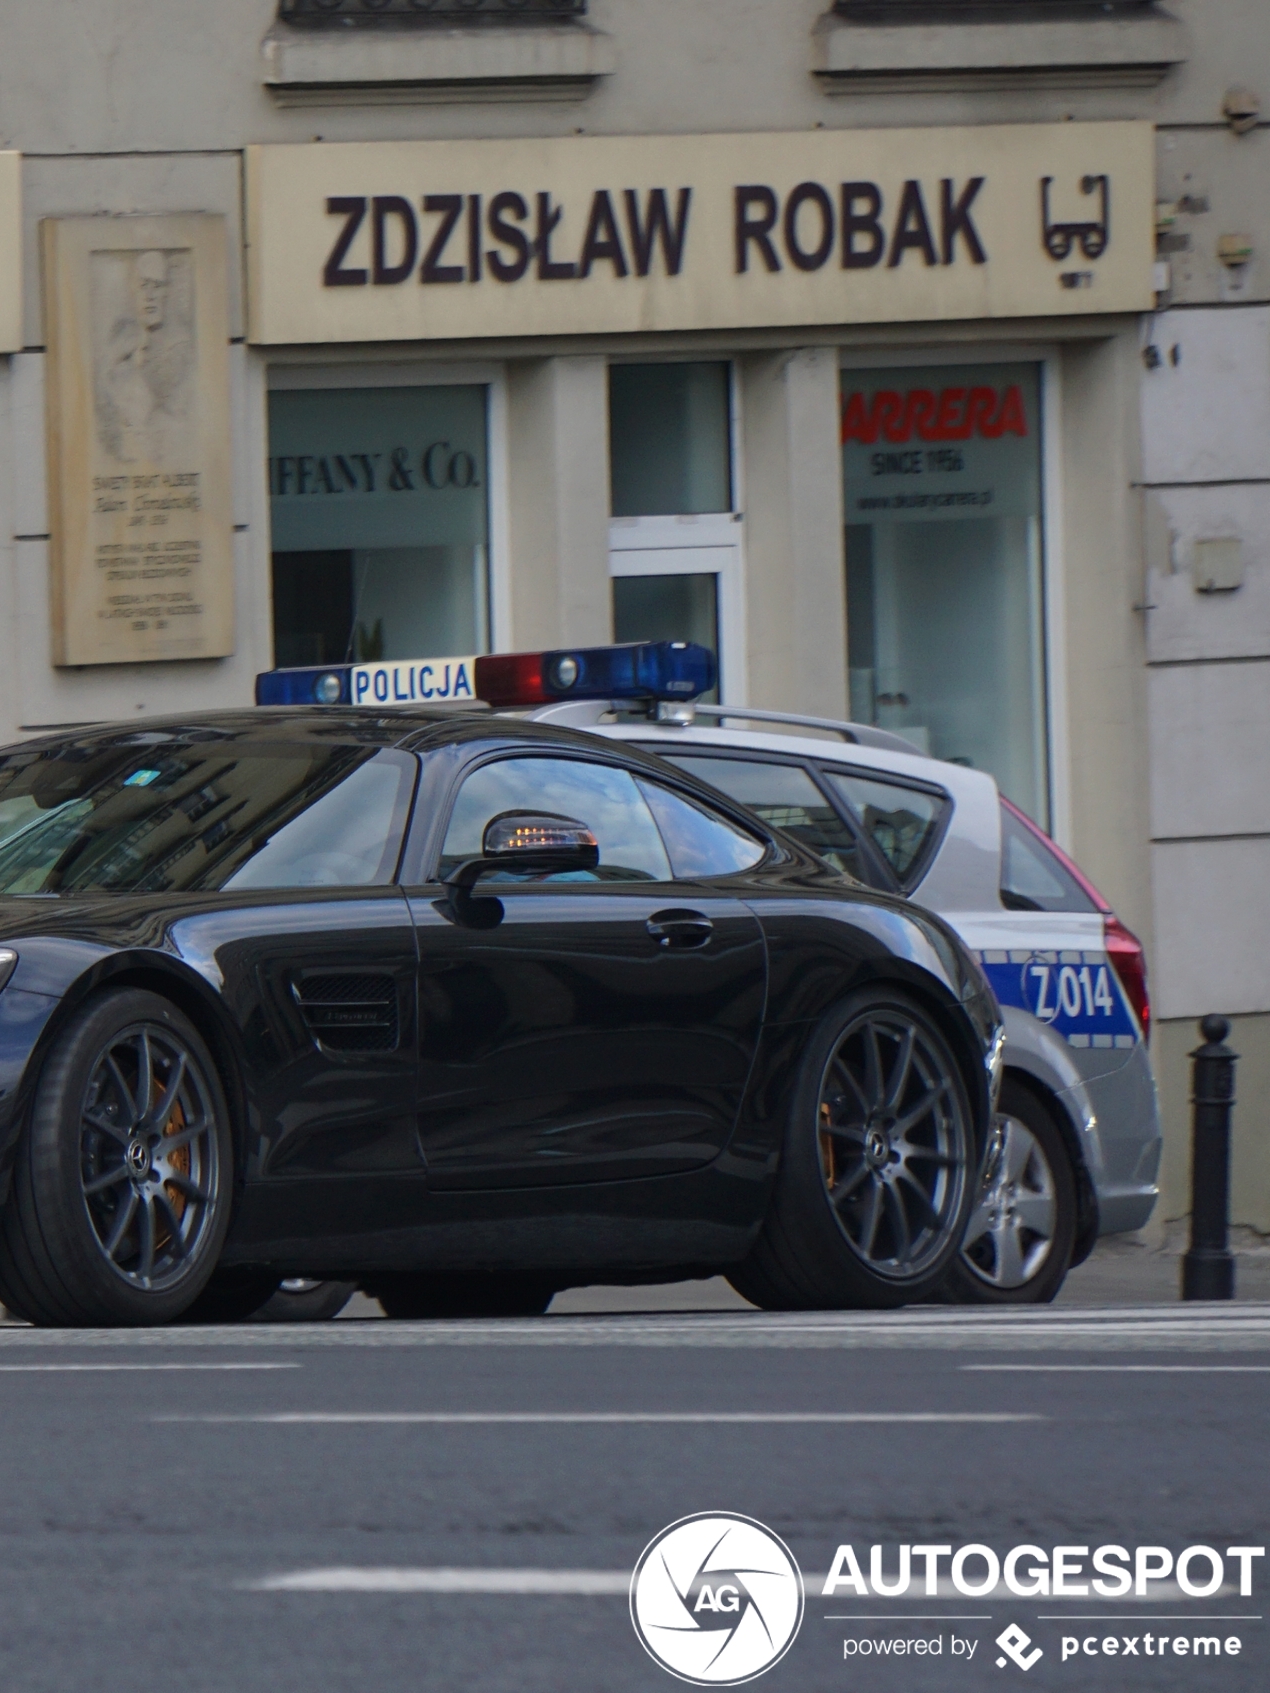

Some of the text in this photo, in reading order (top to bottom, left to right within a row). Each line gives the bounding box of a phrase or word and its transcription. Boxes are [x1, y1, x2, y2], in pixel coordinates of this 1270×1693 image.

[323, 176, 988, 288] ZDZISŁAW ROBAK
[840, 385, 1029, 445] ARRERA
[389, 446, 416, 492] &
[421, 441, 479, 490] Co.
[870, 450, 924, 477] SINCE
[356, 662, 472, 703] POLICJA
[1030, 965, 1114, 1019] Z014
